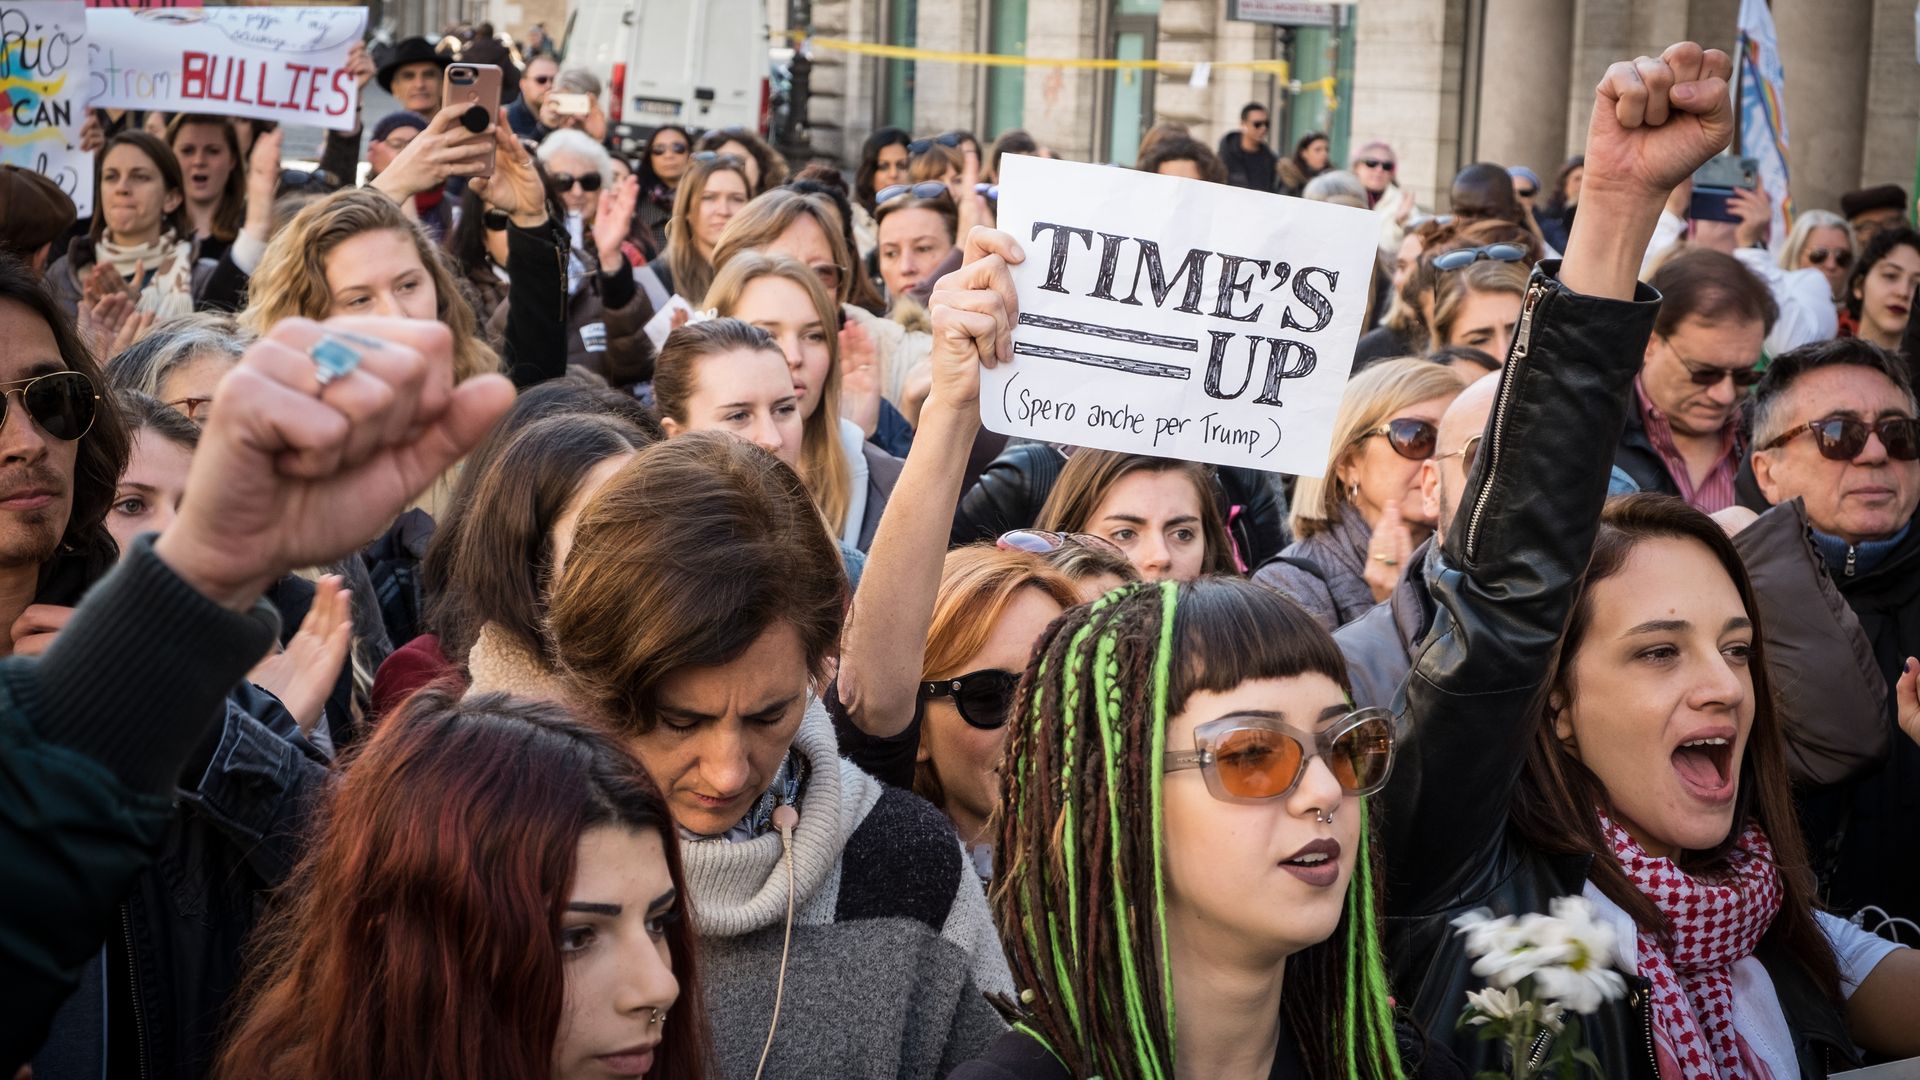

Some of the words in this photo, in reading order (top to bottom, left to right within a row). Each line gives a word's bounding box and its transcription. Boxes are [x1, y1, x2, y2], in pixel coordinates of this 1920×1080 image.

[13, 100, 71, 127] CAN
[180, 51, 350, 116] BULLIES
[1031, 221, 1340, 333] TIME'S
[1203, 330, 1318, 407] UP
[1087, 403, 1145, 433] anche
[1154, 416, 1191, 447] per
